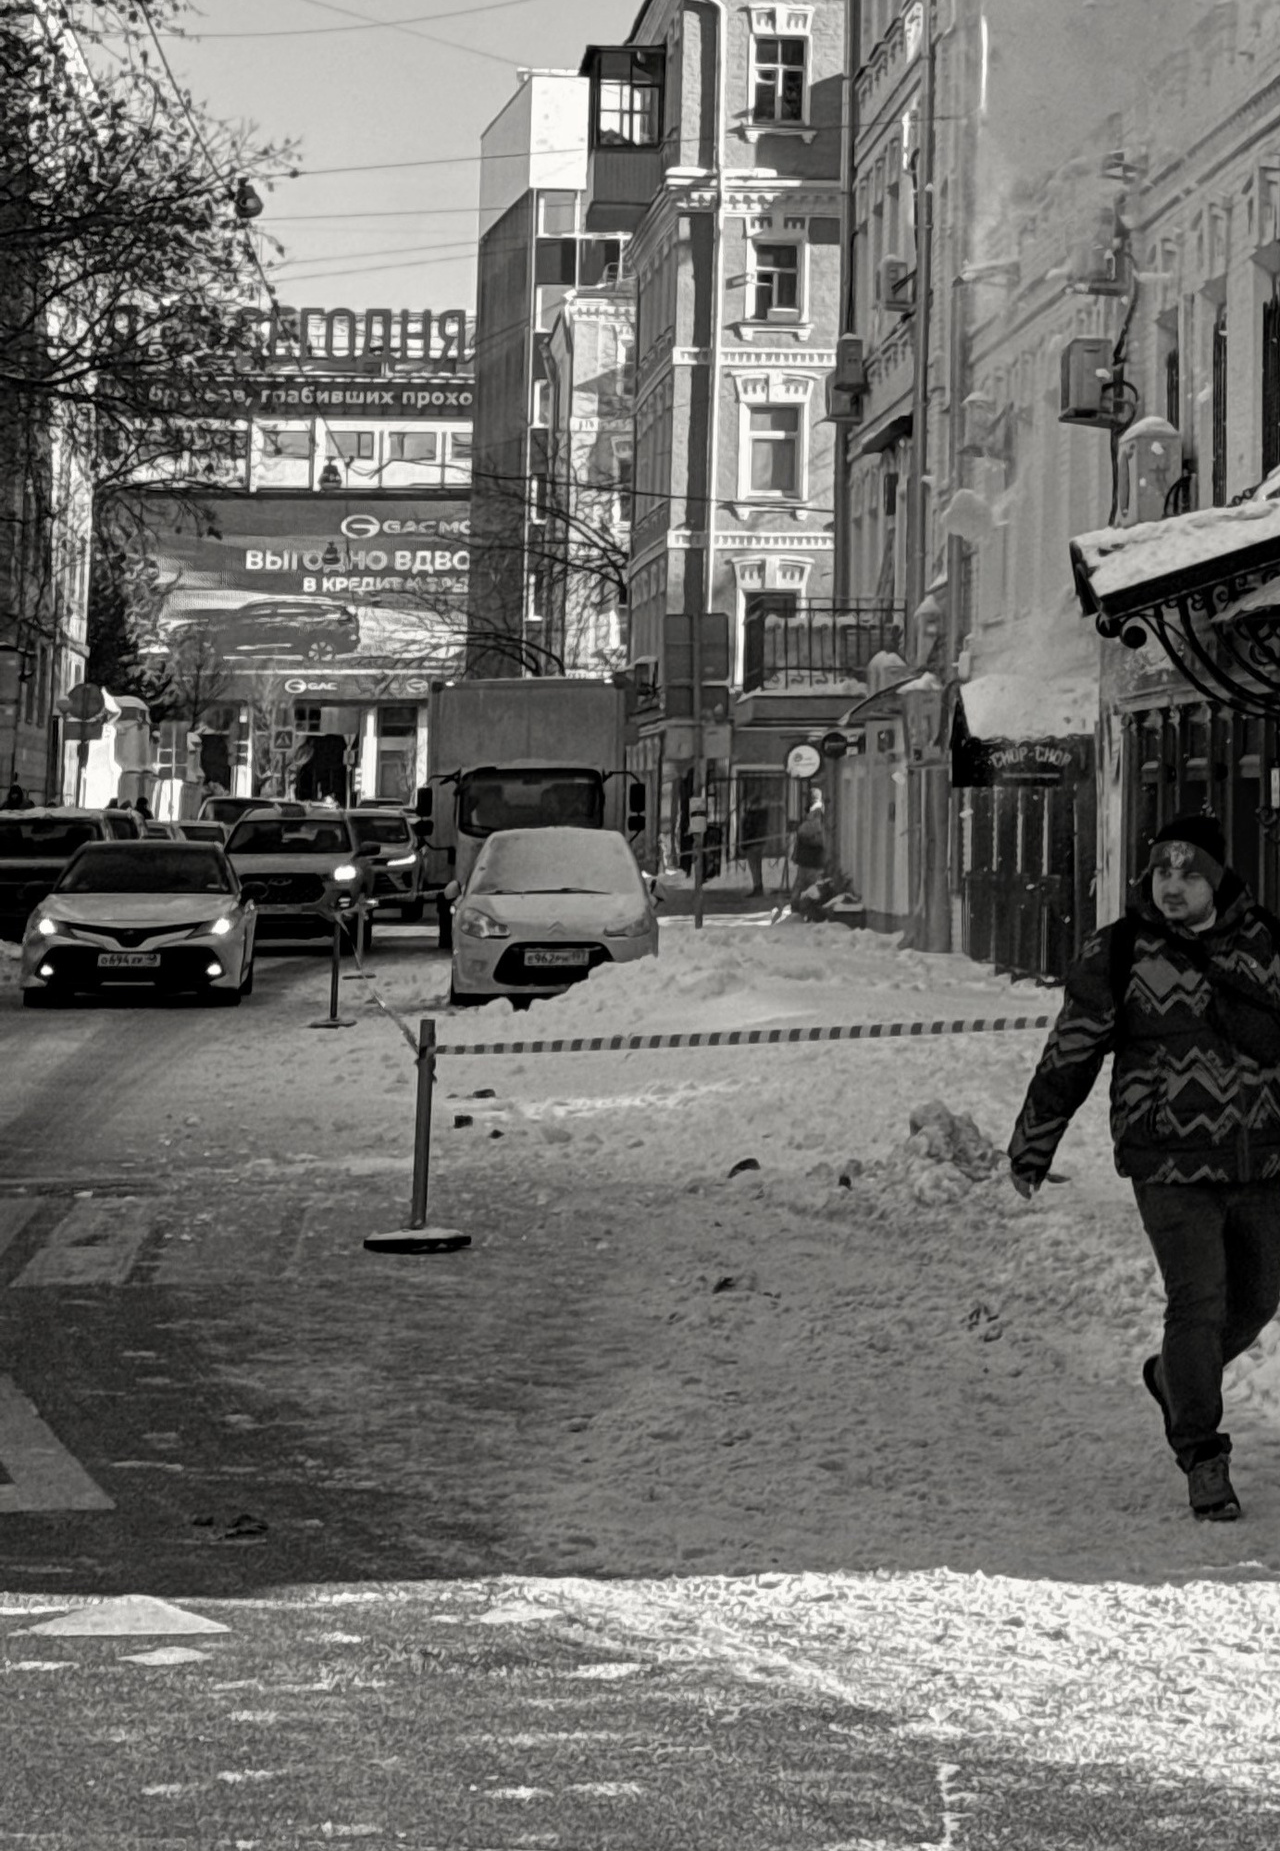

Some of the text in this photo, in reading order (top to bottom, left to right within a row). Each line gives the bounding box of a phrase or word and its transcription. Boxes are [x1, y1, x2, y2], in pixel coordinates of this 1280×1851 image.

[402, 390, 474, 408] прохо
[303, 577, 317, 592] В
[989, 745, 1072, 768] CHOP-CHOP
